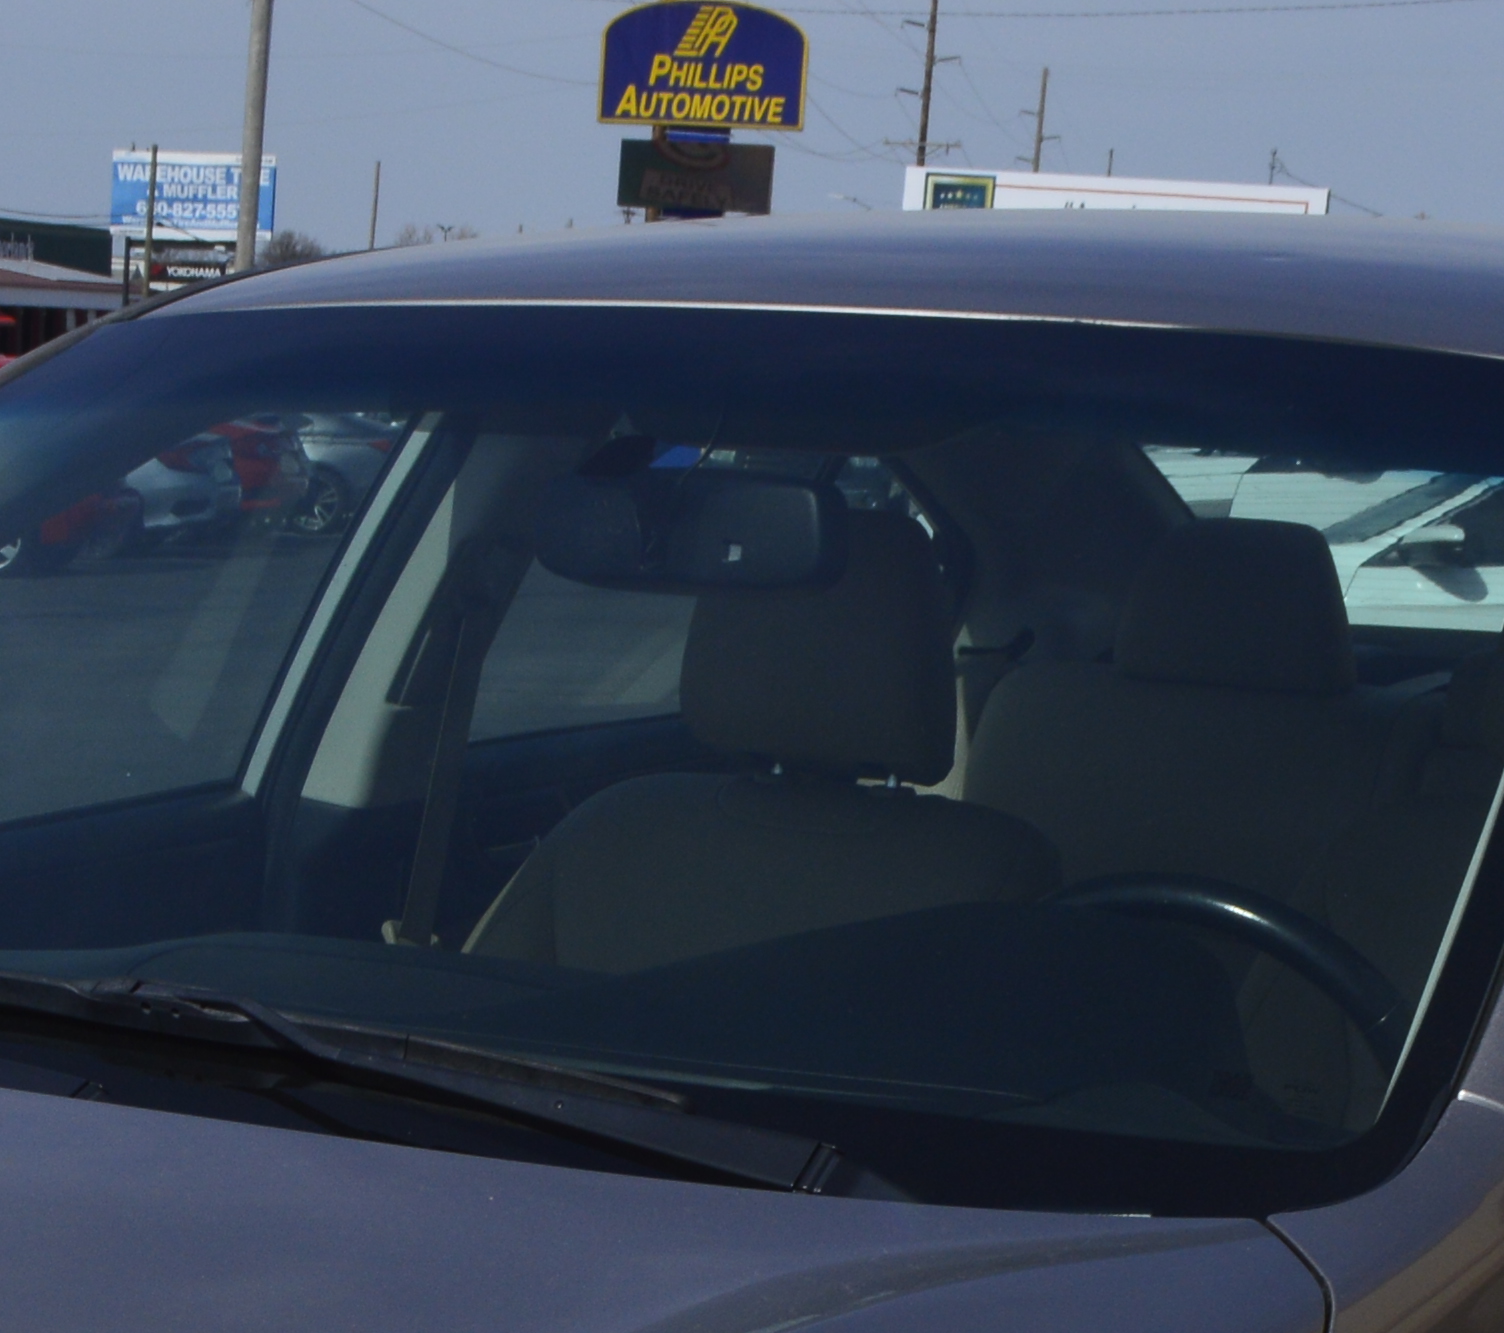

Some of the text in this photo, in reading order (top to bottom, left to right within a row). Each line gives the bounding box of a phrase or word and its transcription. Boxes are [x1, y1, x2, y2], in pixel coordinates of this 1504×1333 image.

[648, 53, 765, 91] PHILLIPS
[615, 84, 786, 123] AUTOMOTIVE
[230, 167, 271, 186] TE
[163, 183, 238, 200] MUFFLER
[135, 200, 241, 220] 60-827-555
[166, 265, 222, 279] YOKOHAMA
